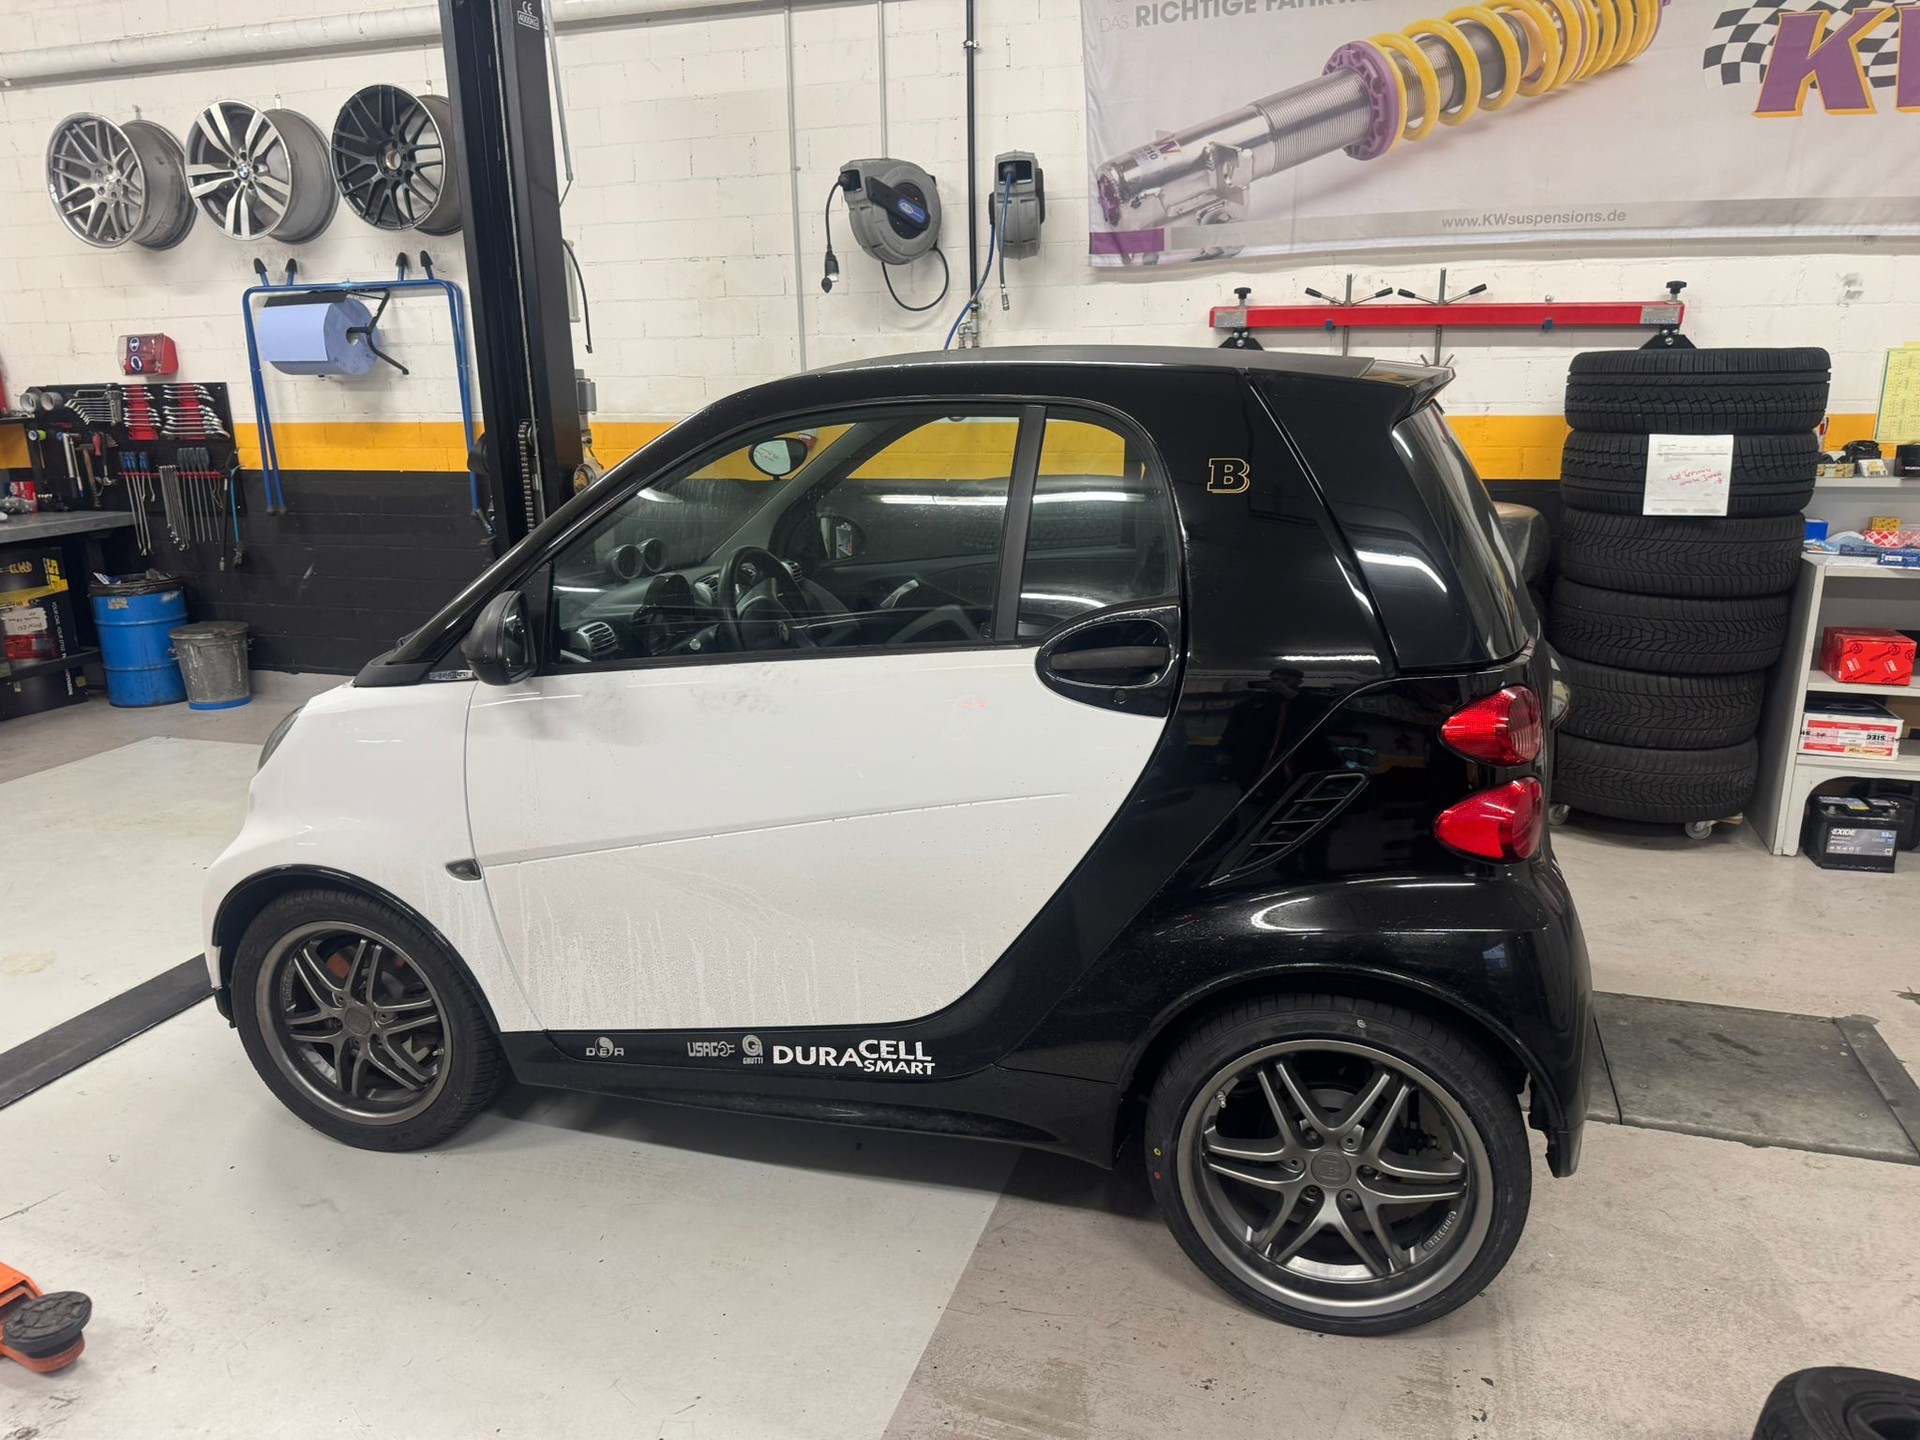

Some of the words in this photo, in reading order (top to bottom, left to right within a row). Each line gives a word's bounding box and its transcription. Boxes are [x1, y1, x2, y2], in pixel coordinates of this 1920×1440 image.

[1100, 14, 1129, 33] DAS
[1135, 0, 1257, 27] RICHTIGE
[1441, 209, 1627, 228] www.KWsuspensions.de
[1207, 457, 1250, 493] B
[1831, 828, 1857, 836] EXIDE
[687, 1041, 719, 1057] USAG
[772, 1039, 933, 1068] DURACELL
[863, 1059, 936, 1075] SMART
